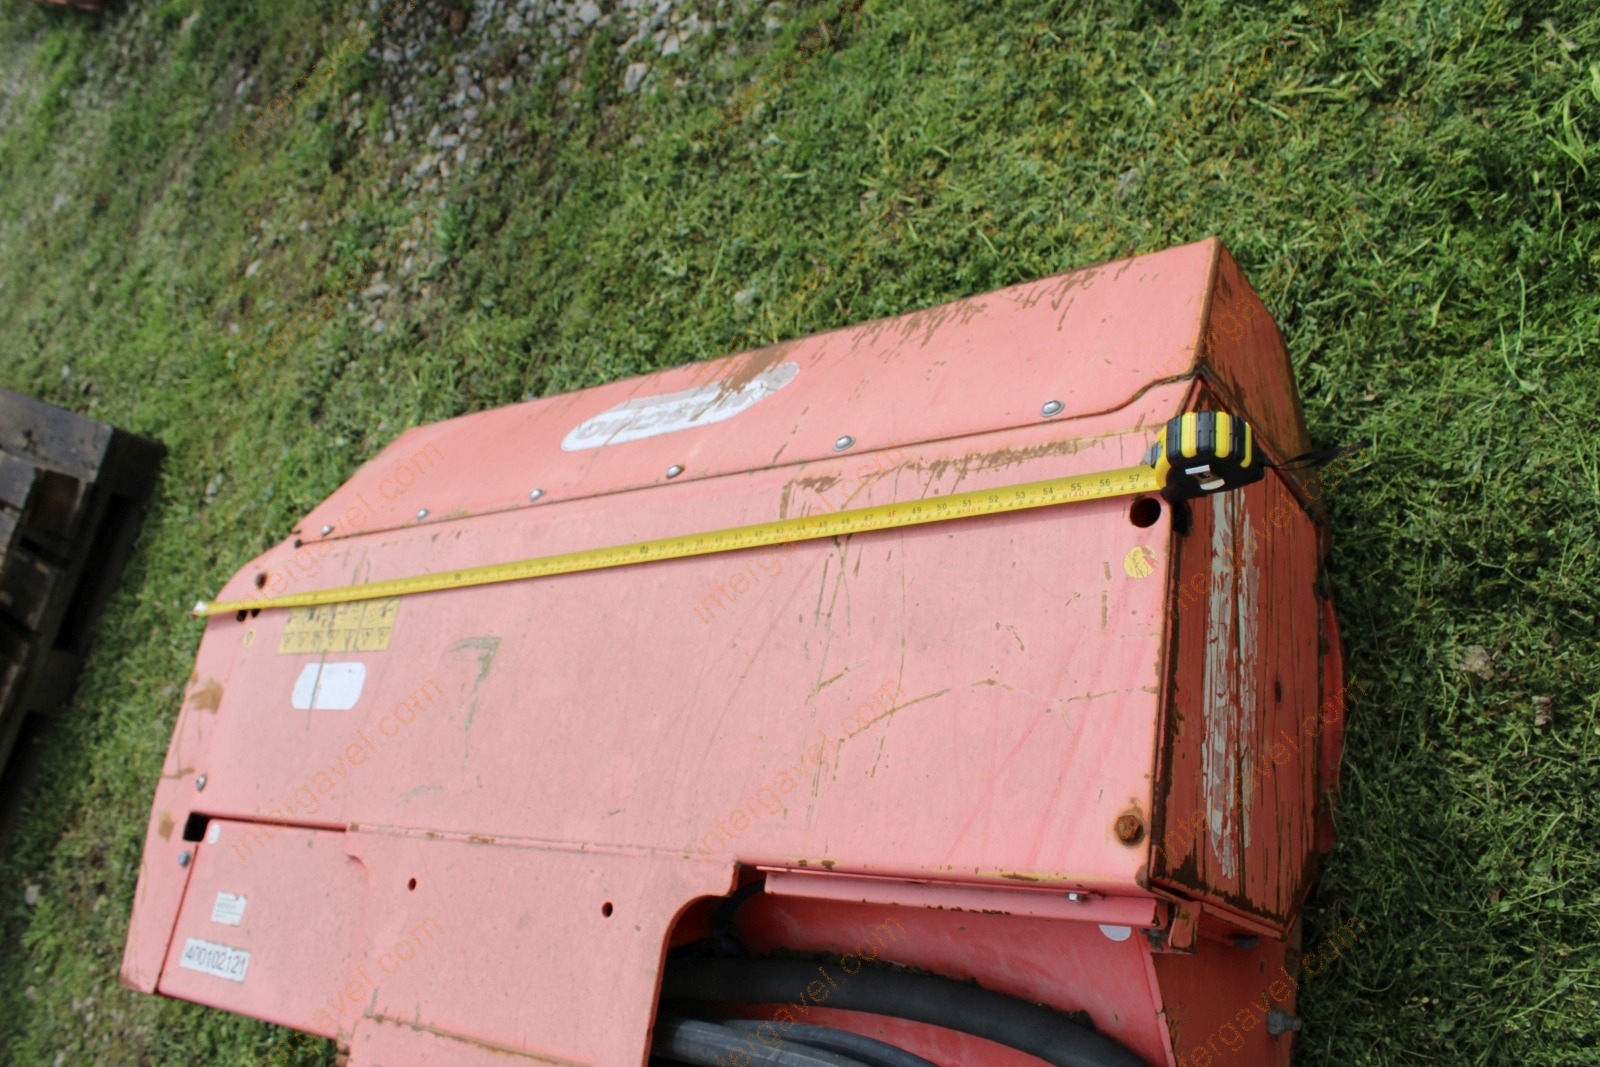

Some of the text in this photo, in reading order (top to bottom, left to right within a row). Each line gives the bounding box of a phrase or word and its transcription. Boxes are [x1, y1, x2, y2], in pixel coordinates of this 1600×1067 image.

[989, 495, 999, 503] 52
[1016, 491, 1026, 499] 53
[1043, 487, 1053, 495] 54
[1071, 483, 1082, 491] 55
[1100, 479, 1110, 487] 56
[1129, 474, 1140, 483] 57
[185, 945, 246, 976] 400102121
